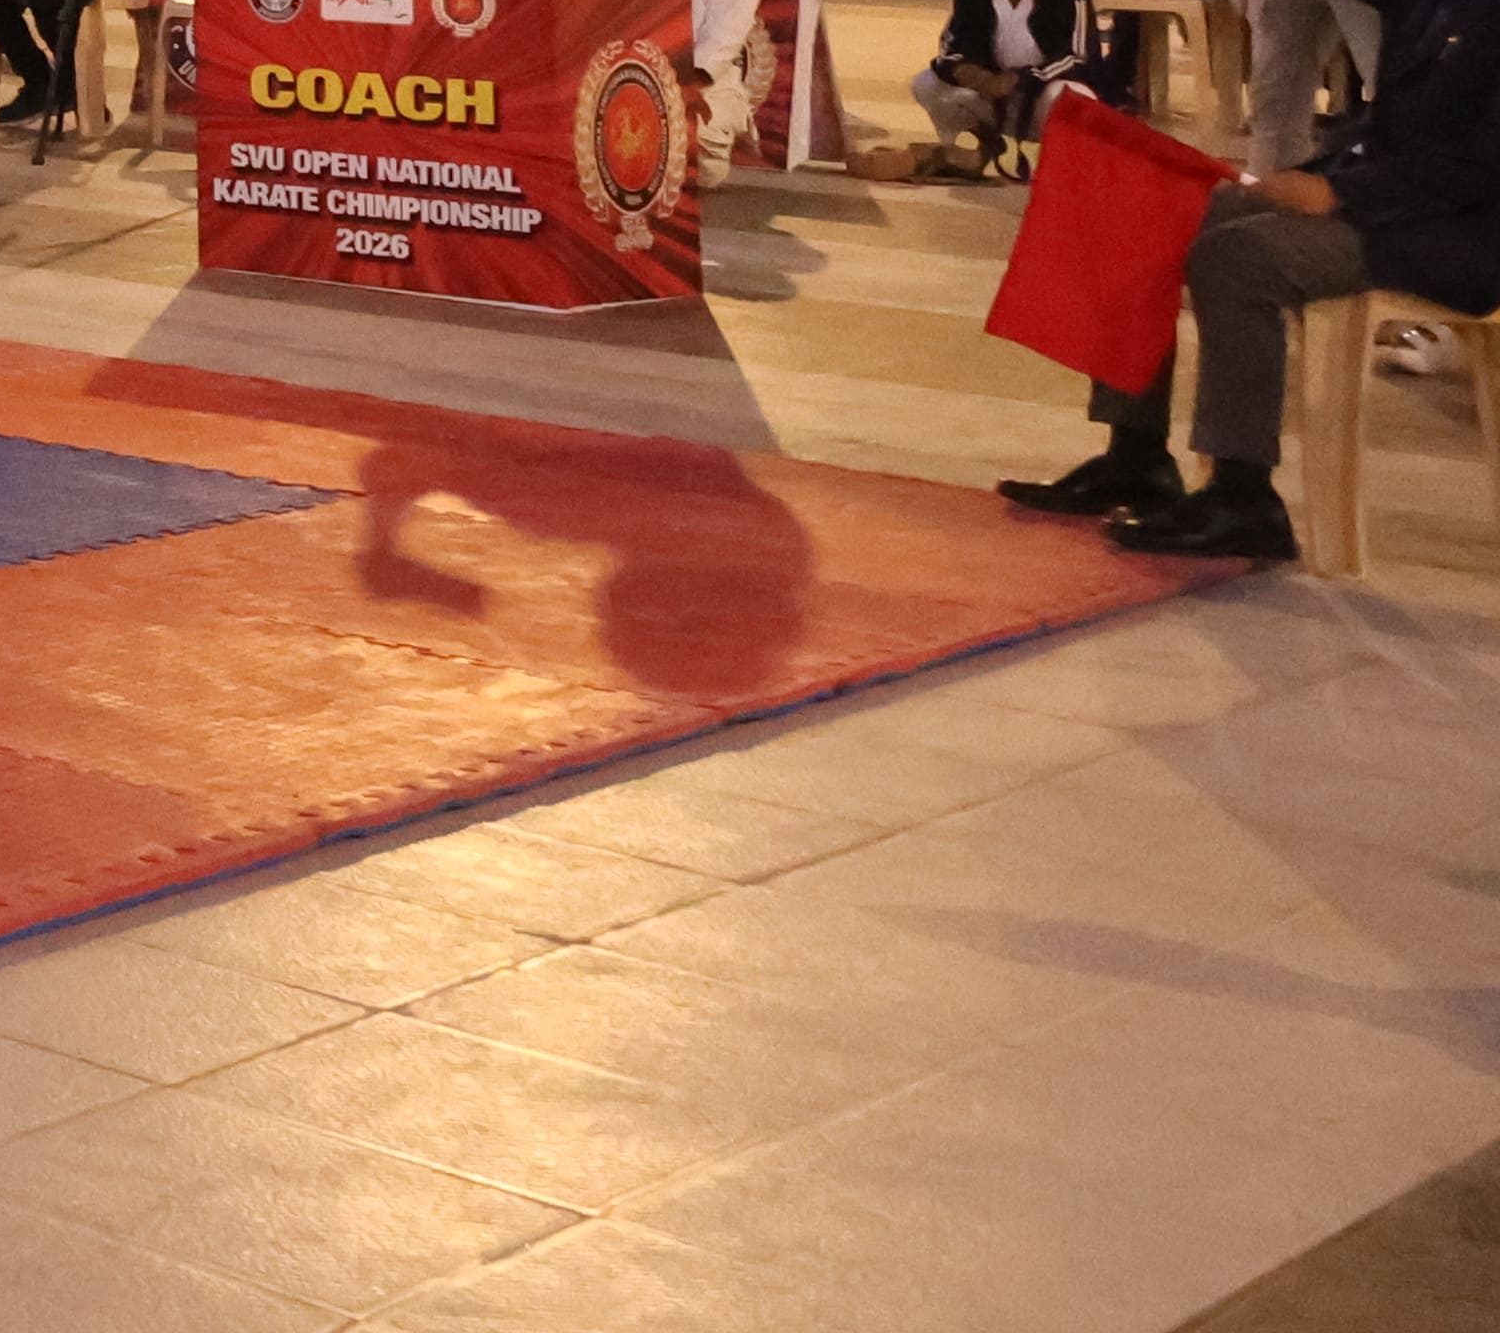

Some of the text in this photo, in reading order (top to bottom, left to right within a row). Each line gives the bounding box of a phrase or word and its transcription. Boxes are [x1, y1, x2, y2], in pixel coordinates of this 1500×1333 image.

[250, 63, 496, 126] COACH
[230, 142, 521, 194] SVU OPEN NATIONAL
[213, 177, 542, 233] KARATE CHIMPIONSHIP
[335, 228, 410, 260] 2026
